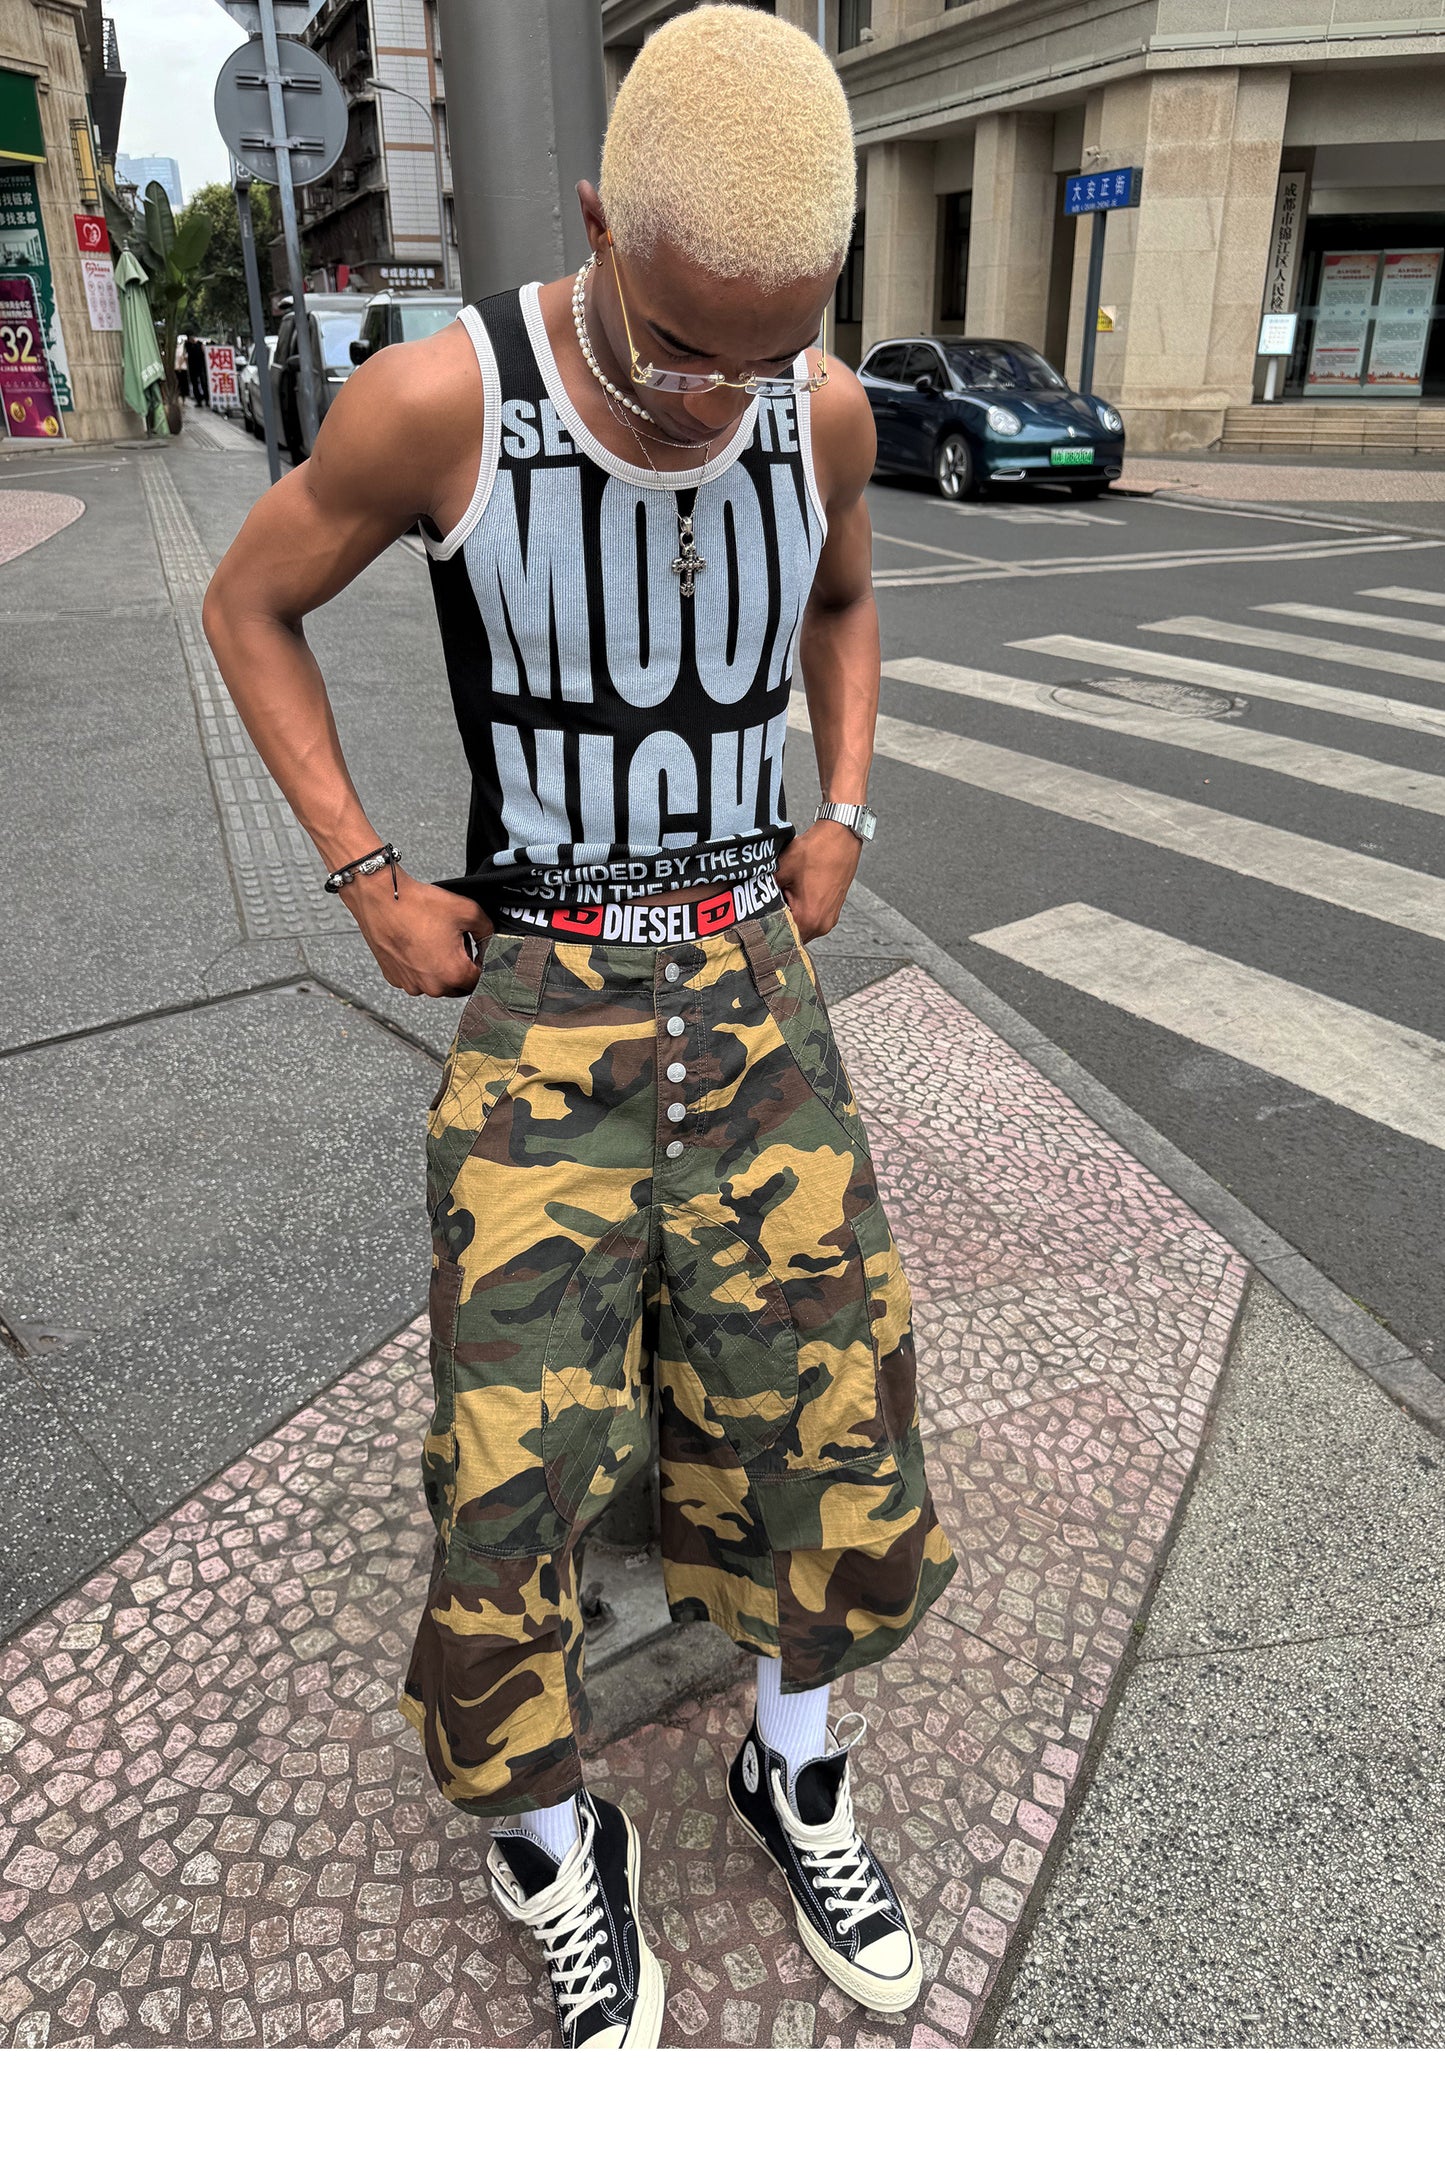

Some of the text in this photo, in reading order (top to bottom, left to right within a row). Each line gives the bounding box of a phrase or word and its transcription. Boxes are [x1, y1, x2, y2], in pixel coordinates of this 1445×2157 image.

[0, 192, 33, 206] 找链家
[1072, 175, 1126, 202] 大安正街
[1270, 183, 1298, 313] 成都市锦江区人民检
[1, 325, 38, 364] 32
[209, 347, 235, 394] 烟酒
[655, 856, 691, 878] BY
[696, 847, 739, 872] THE
[576, 884, 603, 904] IN
[603, 903, 696, 943] DIESEL
